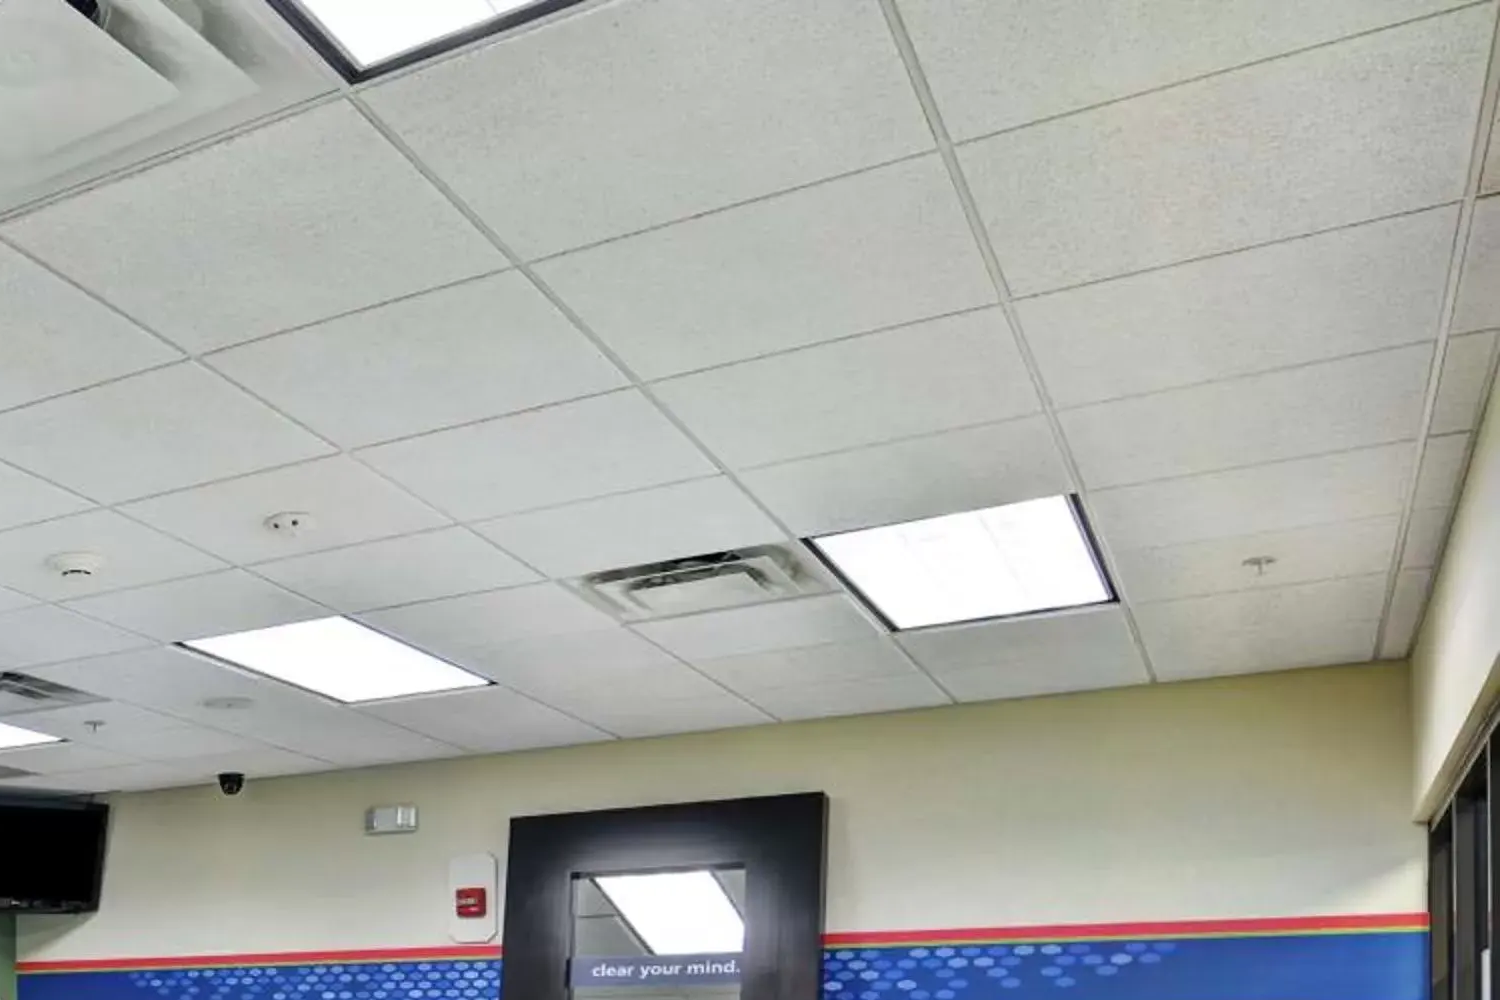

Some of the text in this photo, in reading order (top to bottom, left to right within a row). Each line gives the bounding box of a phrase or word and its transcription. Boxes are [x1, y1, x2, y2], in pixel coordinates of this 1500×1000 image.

[591, 959, 741, 979] clear your mind.
